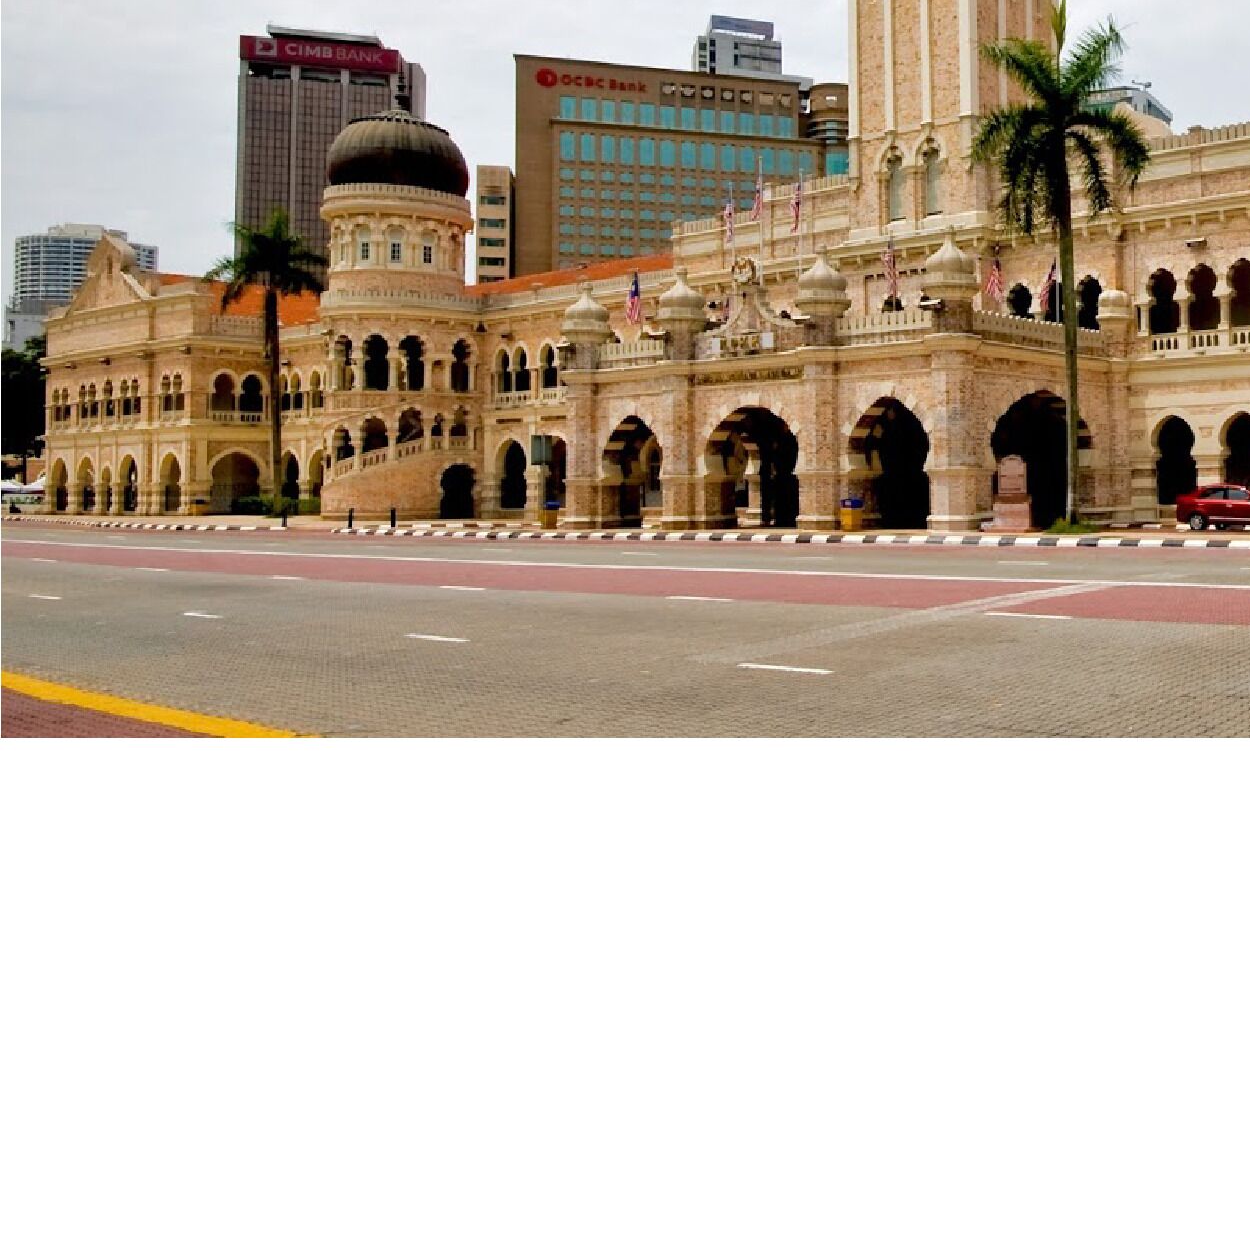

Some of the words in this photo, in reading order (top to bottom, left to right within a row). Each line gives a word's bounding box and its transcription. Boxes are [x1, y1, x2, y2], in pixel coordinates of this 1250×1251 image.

[285, 43, 333, 59] CIMB
[336, 47, 383, 64] BANK
[560, 74, 605, 89] OCBC
[609, 78, 648, 93] Bank
